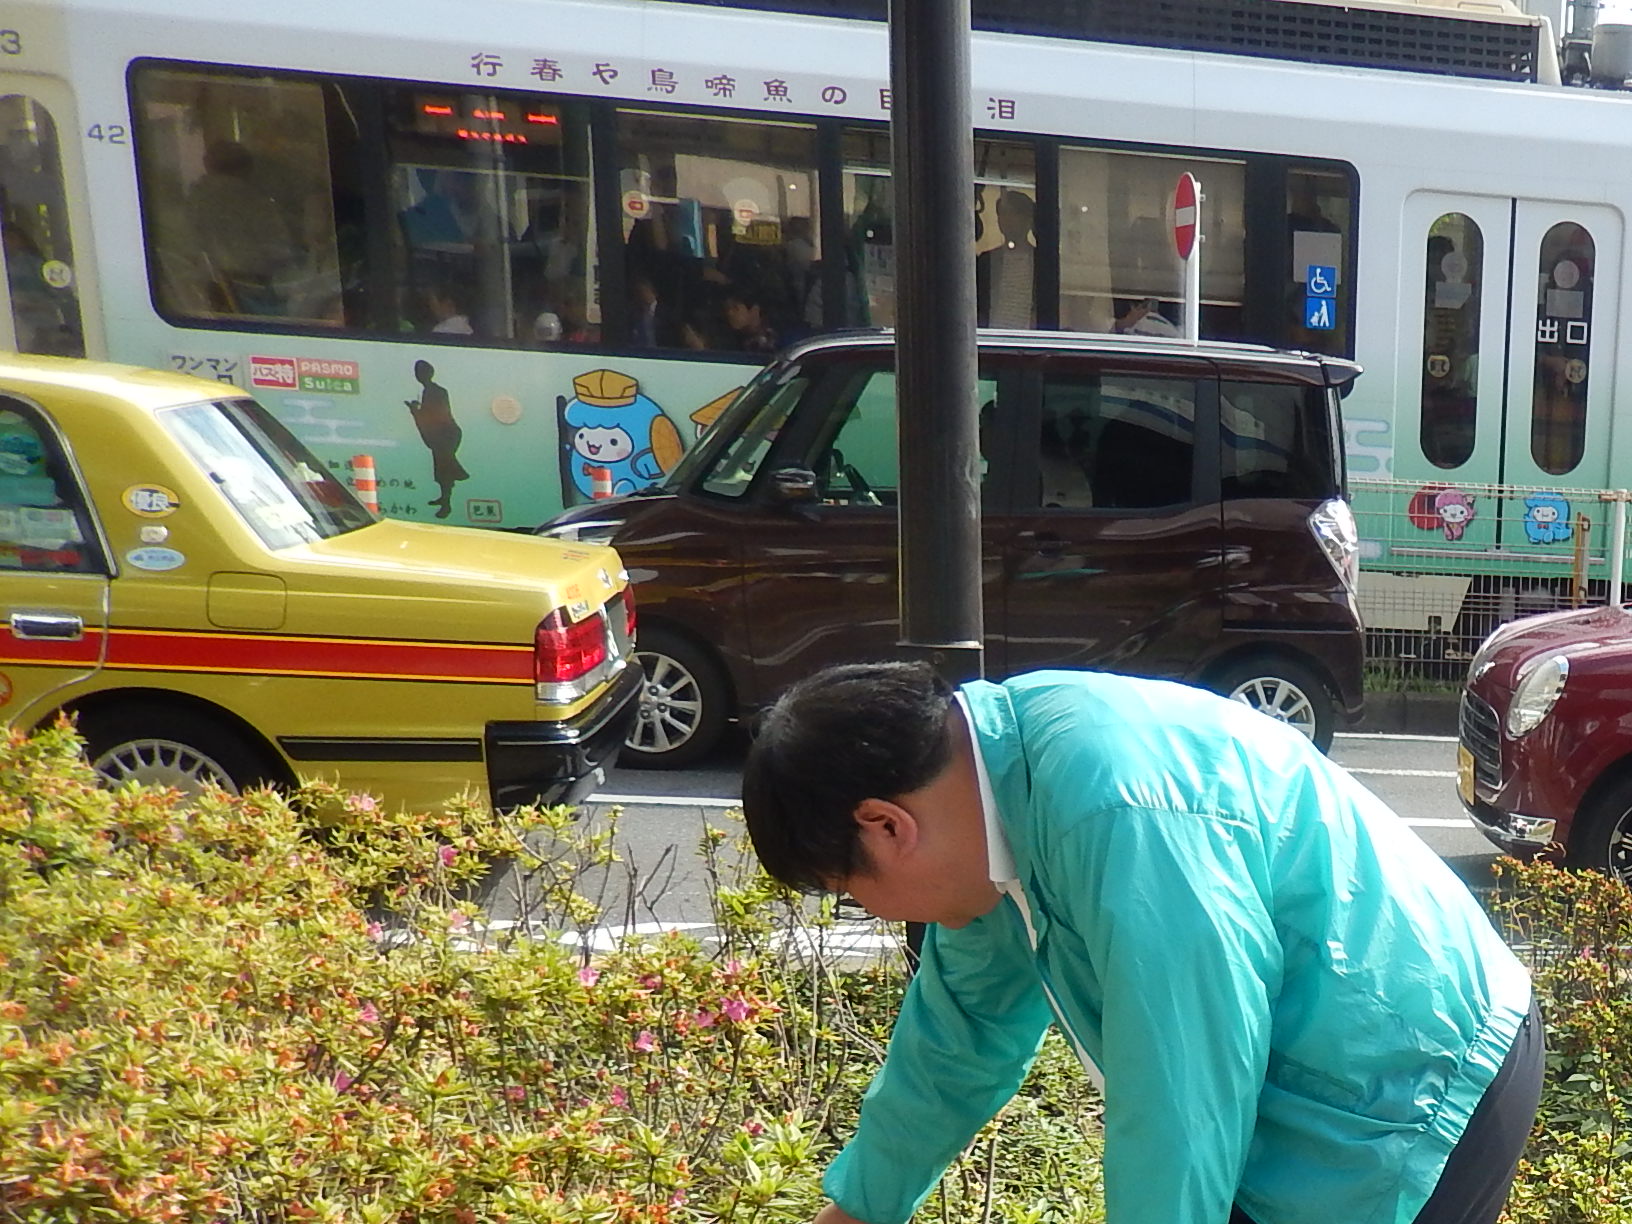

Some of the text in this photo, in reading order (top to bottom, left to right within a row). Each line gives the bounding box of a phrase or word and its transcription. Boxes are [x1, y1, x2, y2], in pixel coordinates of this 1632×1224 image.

[87, 123, 126, 145] 42
[1537, 318, 1588, 345] 出口
[171, 354, 238, 372] ワンマン
[301, 361, 353, 376] PASMO
